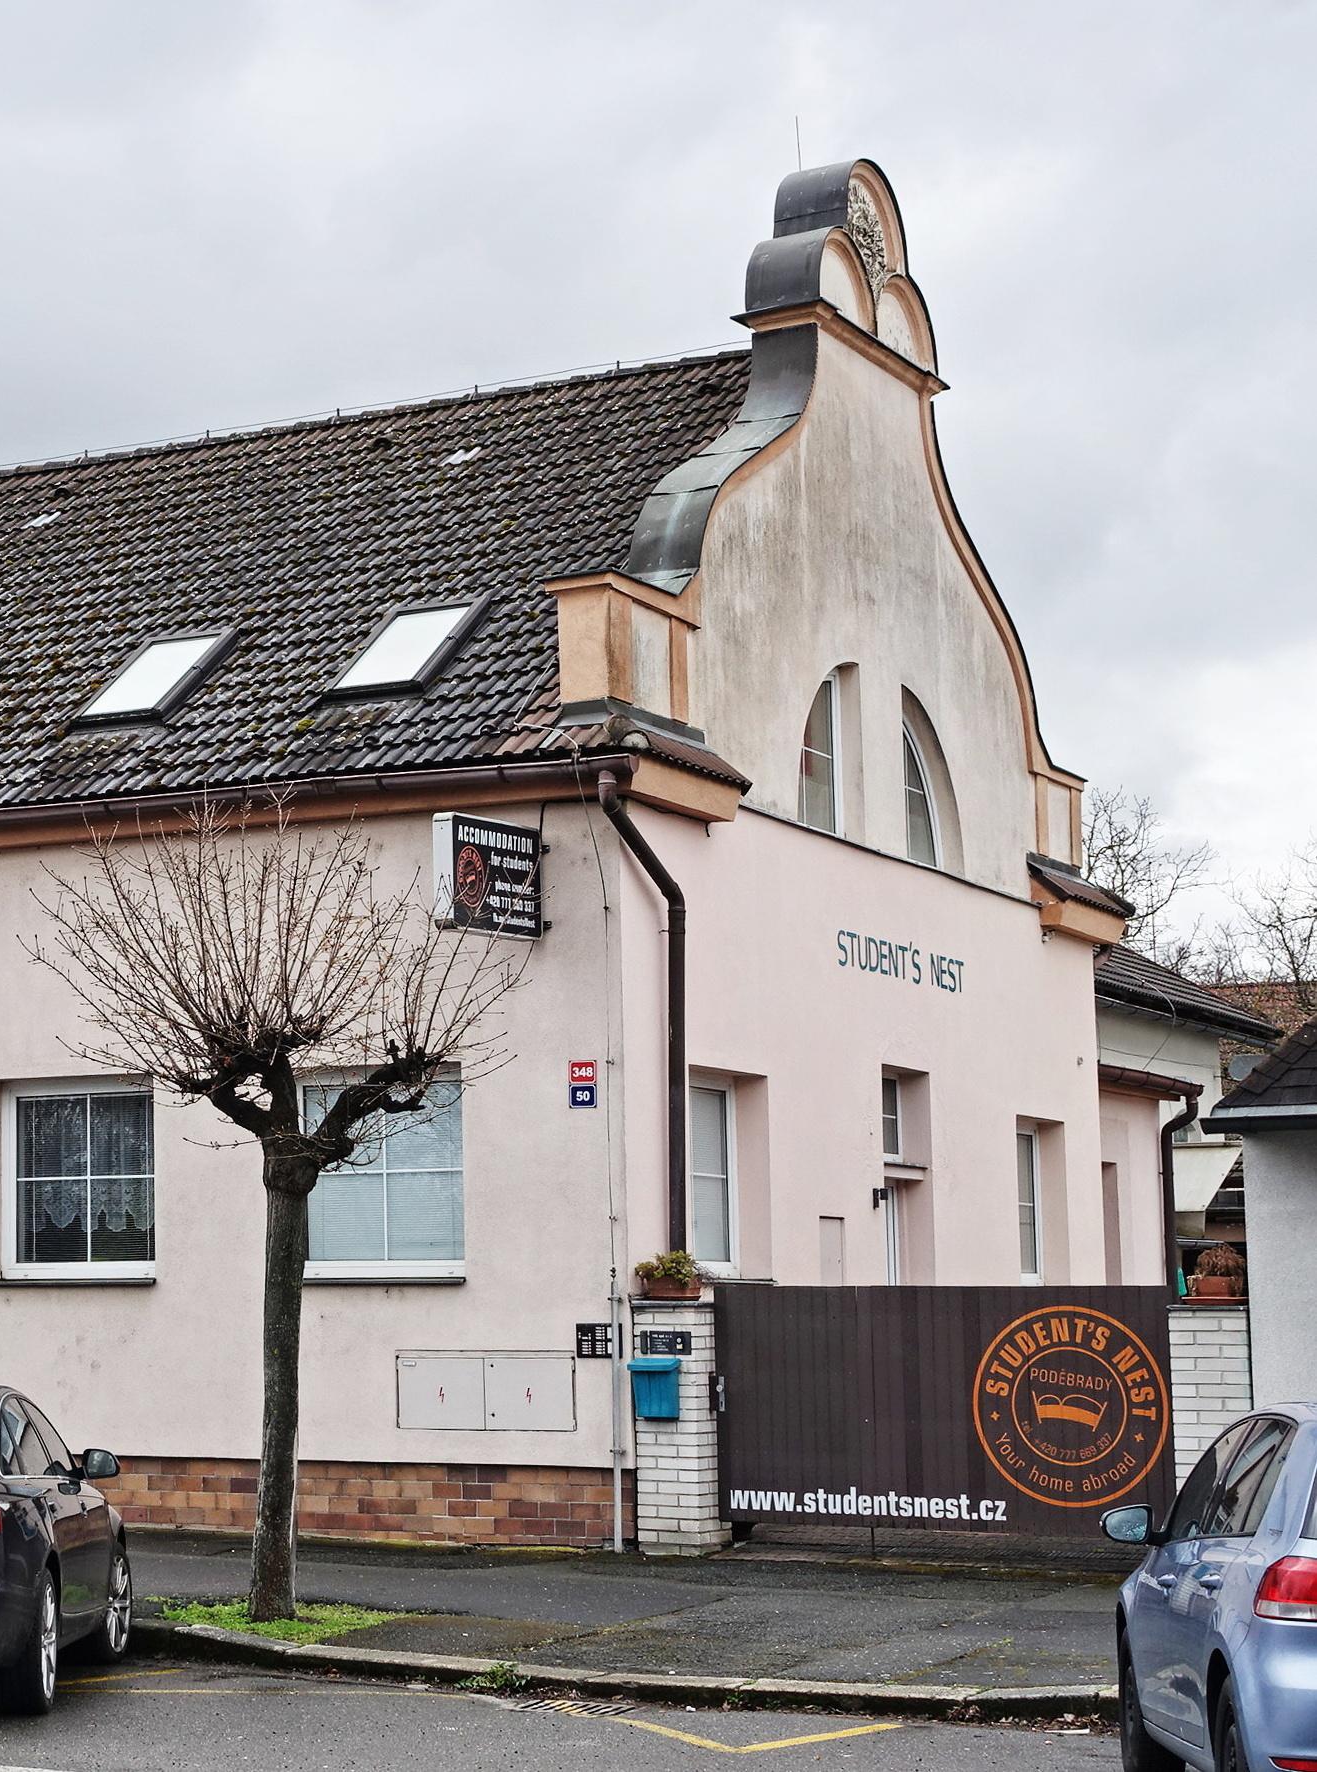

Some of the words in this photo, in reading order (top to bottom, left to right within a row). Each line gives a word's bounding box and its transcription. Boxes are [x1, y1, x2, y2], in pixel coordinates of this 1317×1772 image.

[457, 824, 533, 854] ACCOMMODATION
[490, 851, 502, 867] for
[503, 855, 534, 872] students
[501, 896, 512, 910] 777
[837, 929, 922, 985] STUDENT'S
[929, 952, 964, 993] NEST
[572, 1066, 594, 1078] 348
[575, 1090, 591, 1102] 50
[985, 1317, 1112, 1397] STUDENT'S
[1111, 1345, 1157, 1421] NEST
[1058, 1448, 1077, 1460] 777
[1079, 1444, 1098, 1460] 669
[1096, 1432, 1113, 1451] 337
[995, 1432, 1026, 1470] Your
[1028, 1464, 1075, 1493] home
[1082, 1451, 1137, 1493] abroad
[730, 1486, 1008, 1522] www.studentsnest.cz
